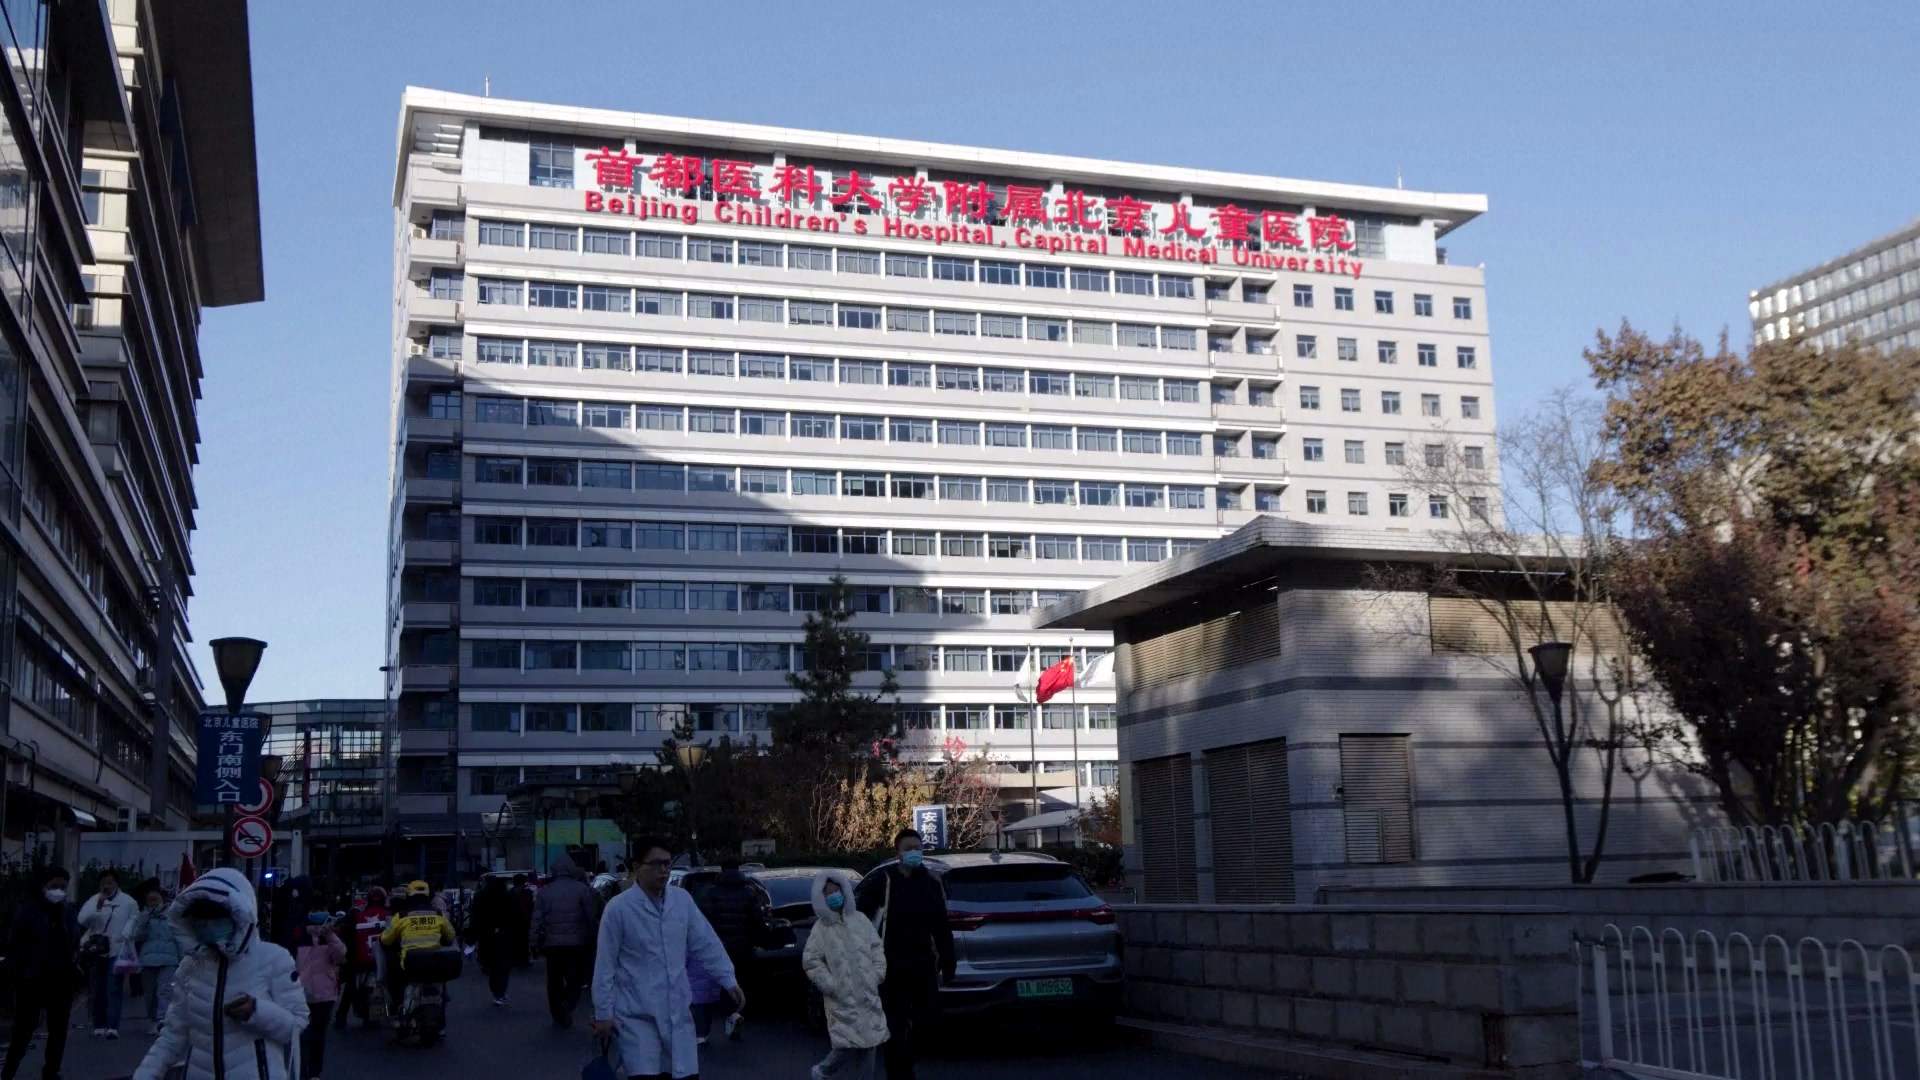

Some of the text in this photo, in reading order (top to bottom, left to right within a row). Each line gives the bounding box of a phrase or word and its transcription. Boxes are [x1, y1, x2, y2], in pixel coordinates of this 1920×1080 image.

[584, 145, 1355, 251] 首都医科大学附属北京儿童医院
[584, 190, 698, 225] Beijing
[714, 199, 868, 235] Children's
[1014, 226, 1108, 255] Capital
[1122, 236, 1218, 264] Medical
[1231, 244, 1363, 280] University
[203, 716, 259, 729] 北京儿童医院
[213, 730, 244, 803] 东门南侧入口
[920, 811, 939, 845] 安检处
